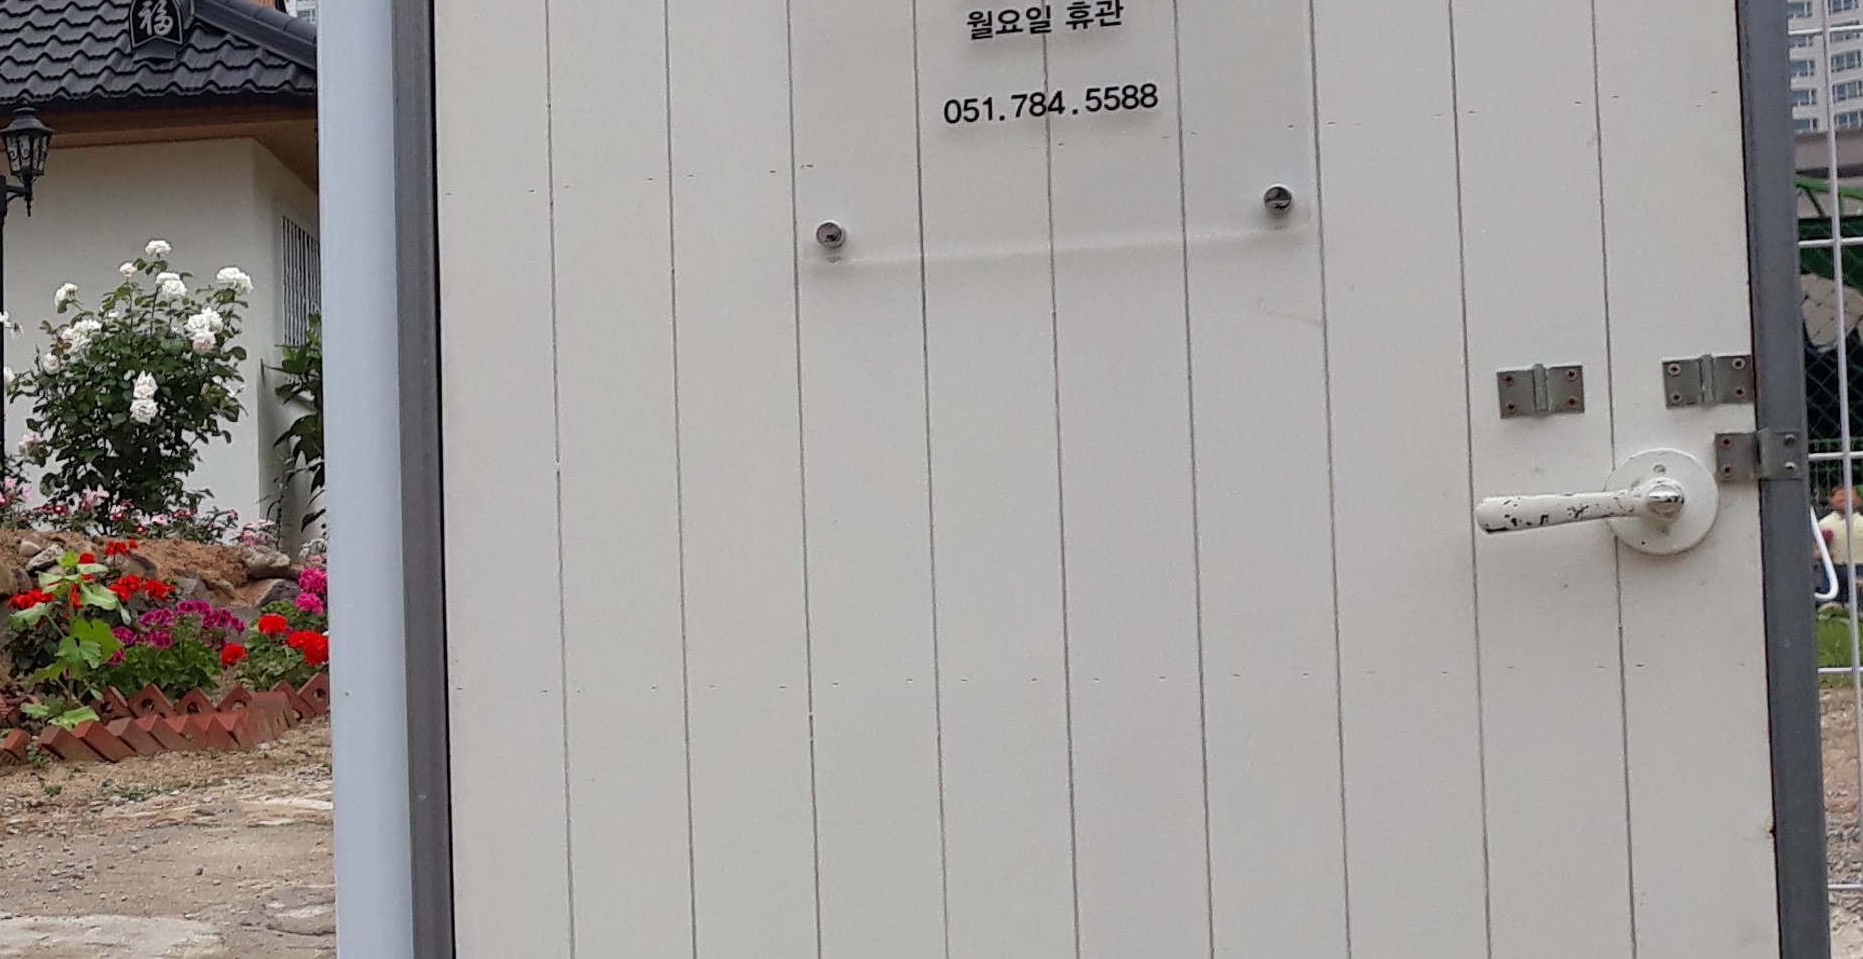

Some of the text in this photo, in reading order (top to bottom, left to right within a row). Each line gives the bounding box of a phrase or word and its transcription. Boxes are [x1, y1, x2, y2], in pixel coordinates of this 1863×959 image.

[137, 0, 174, 36] 福
[966, 4, 1052, 41] 월요일
[943, 83, 1159, 124] 051.784.5588
